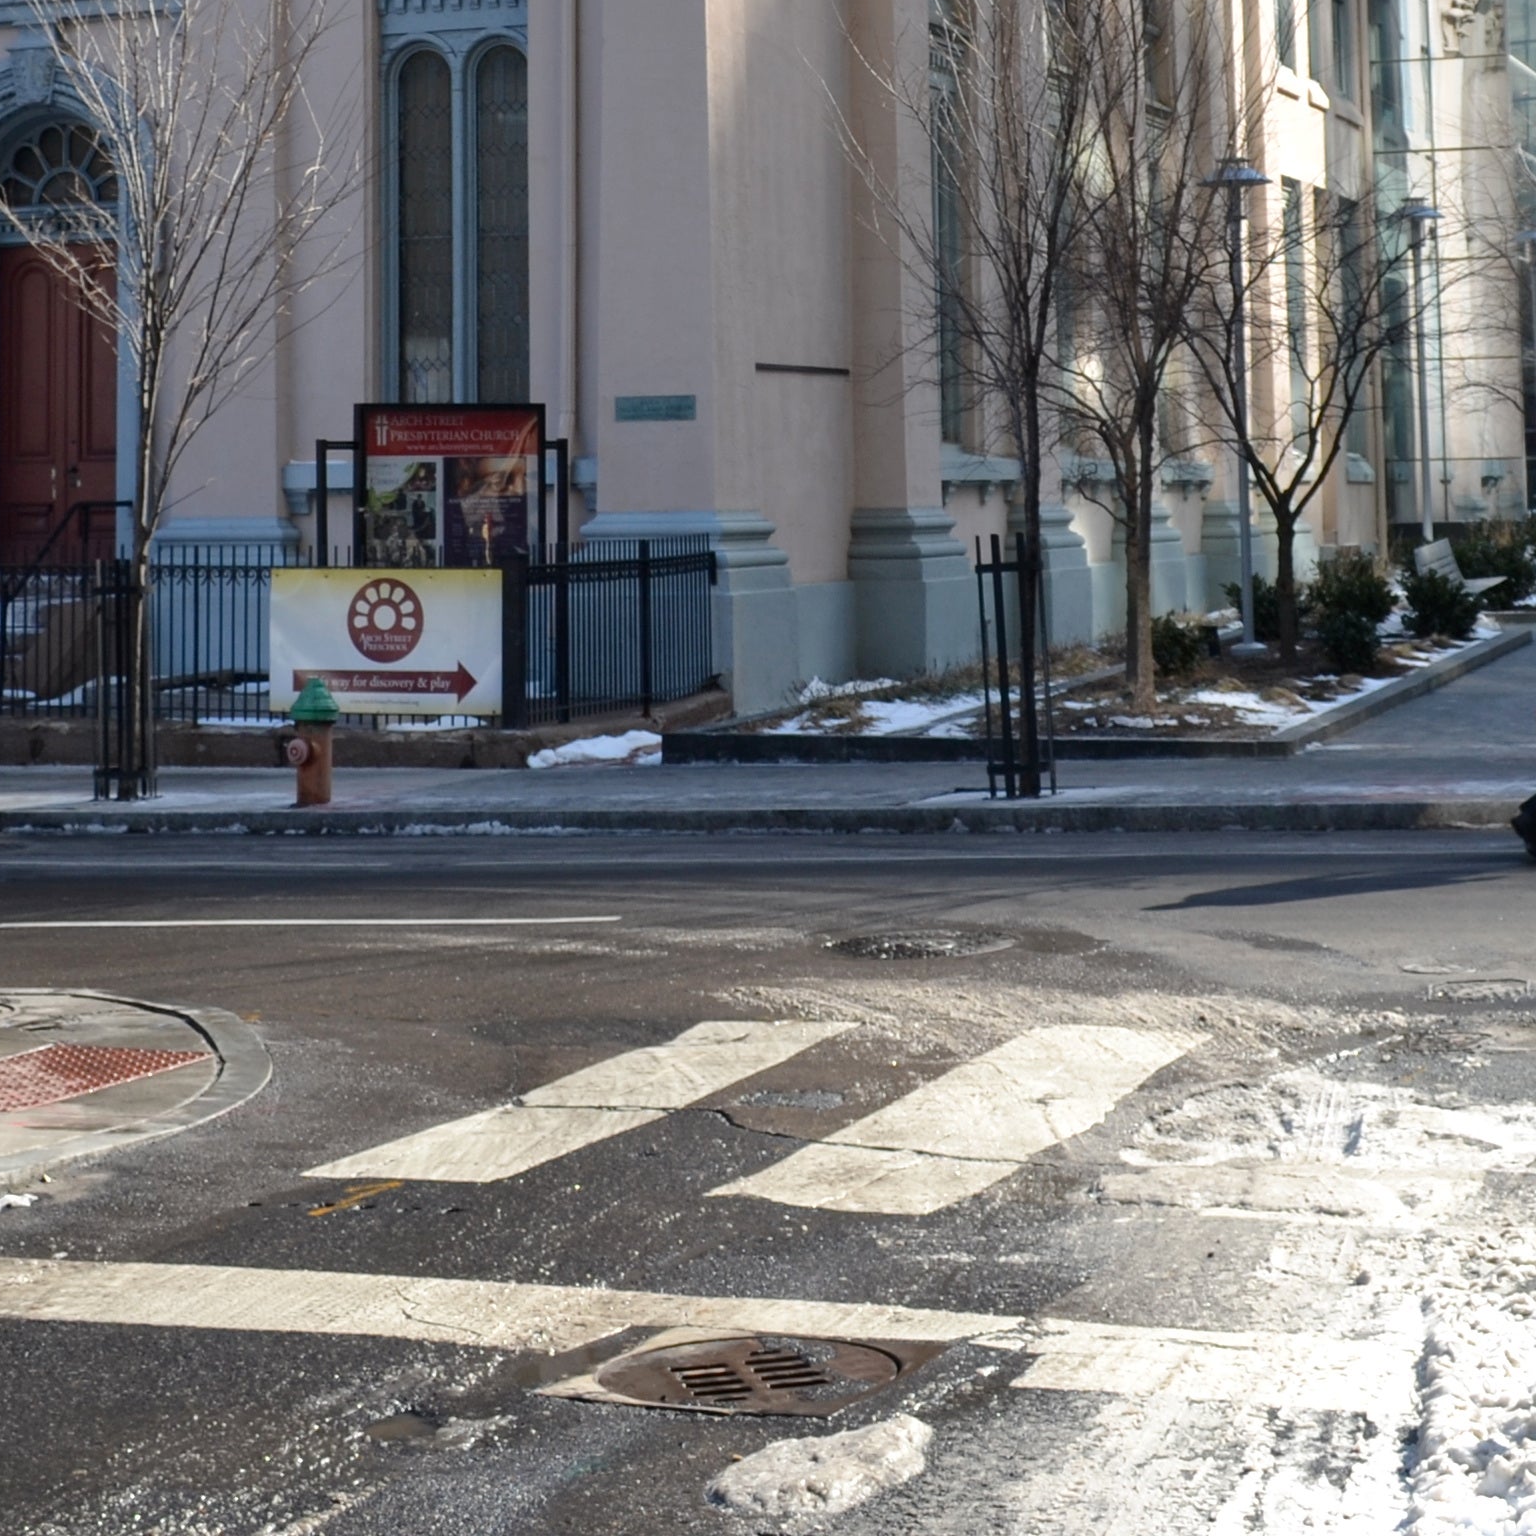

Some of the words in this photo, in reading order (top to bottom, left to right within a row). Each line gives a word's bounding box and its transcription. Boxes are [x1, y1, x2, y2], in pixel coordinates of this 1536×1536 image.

[390, 415, 423, 426] ARCH
[425, 415, 464, 426] STREET
[390, 430, 469, 442] PRESBYTERIAN
[470, 429, 520, 441] CHURCH
[331, 678, 351, 689] way
[352, 675, 367, 688] for
[369, 676, 414, 689] discovery
[417, 677, 428, 688] &
[430, 676, 451, 691] play
